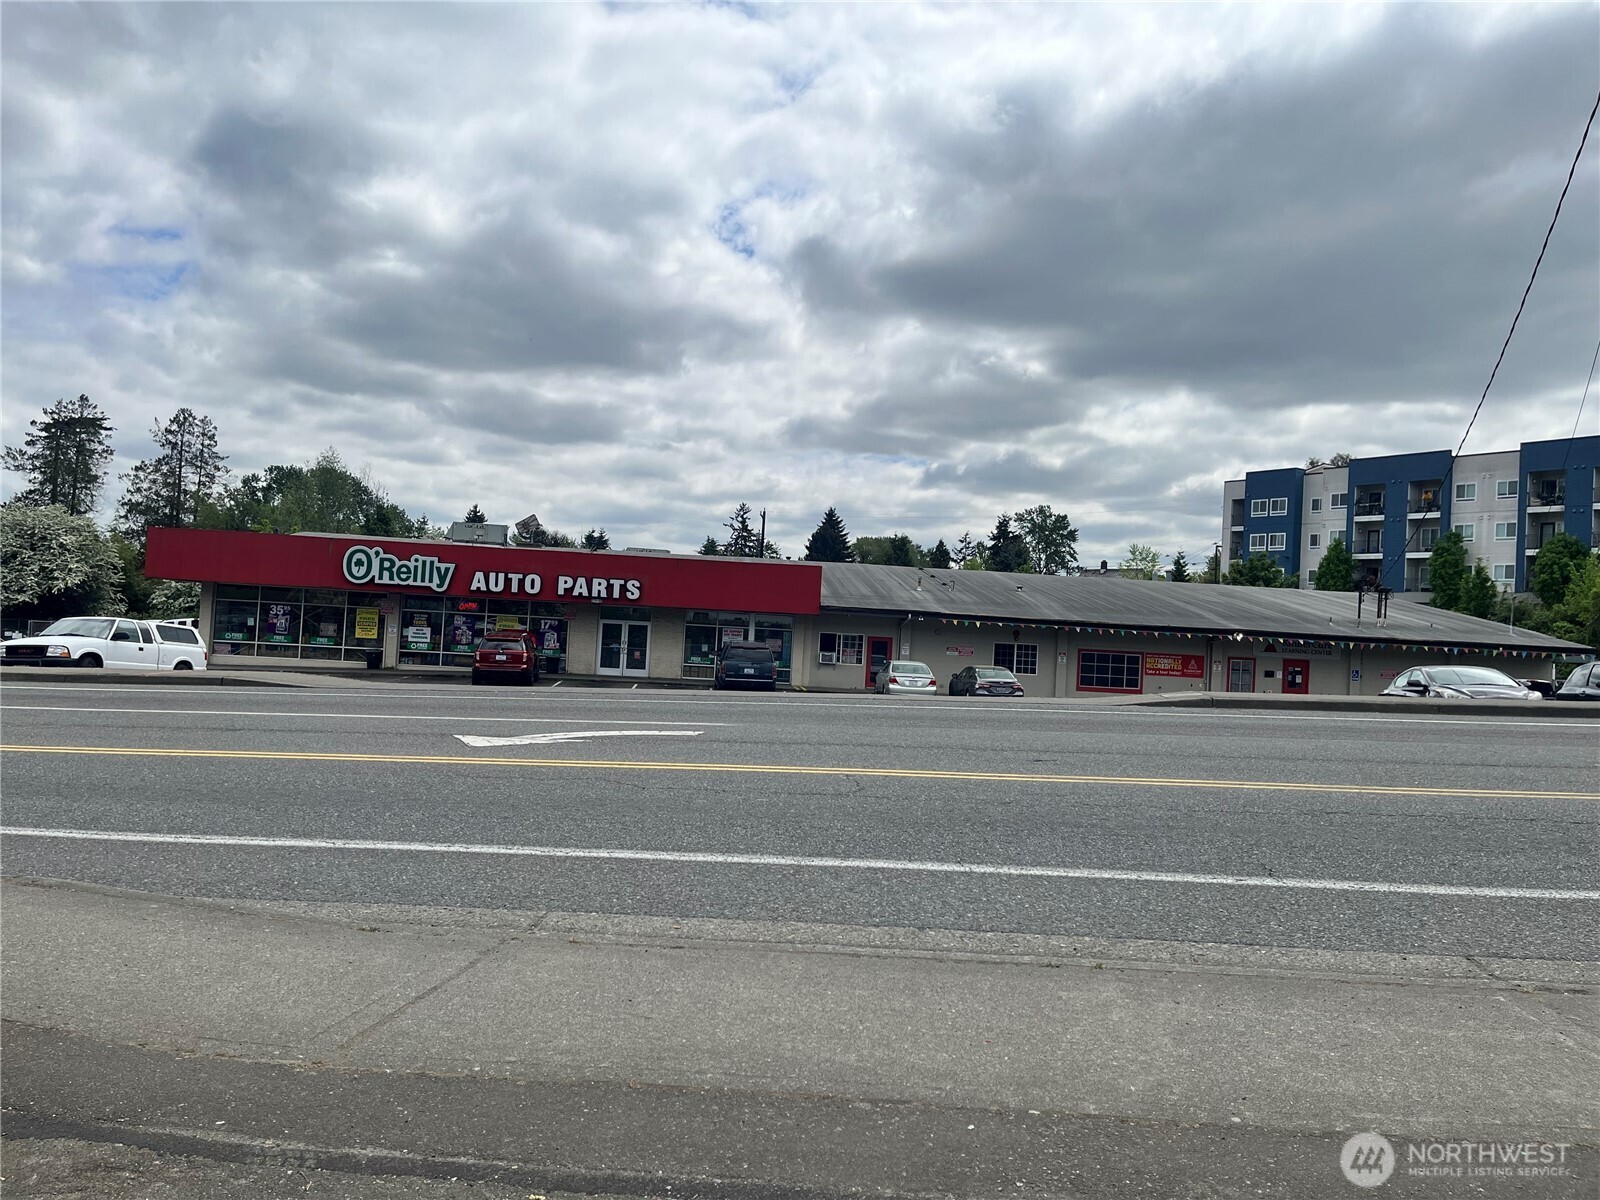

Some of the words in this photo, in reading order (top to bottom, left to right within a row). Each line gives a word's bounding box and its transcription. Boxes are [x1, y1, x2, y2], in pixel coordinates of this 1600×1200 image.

[345, 547, 453, 590] O'Reilly
[470, 571, 541, 594] AUTO
[557, 575, 641, 600] PARTS
